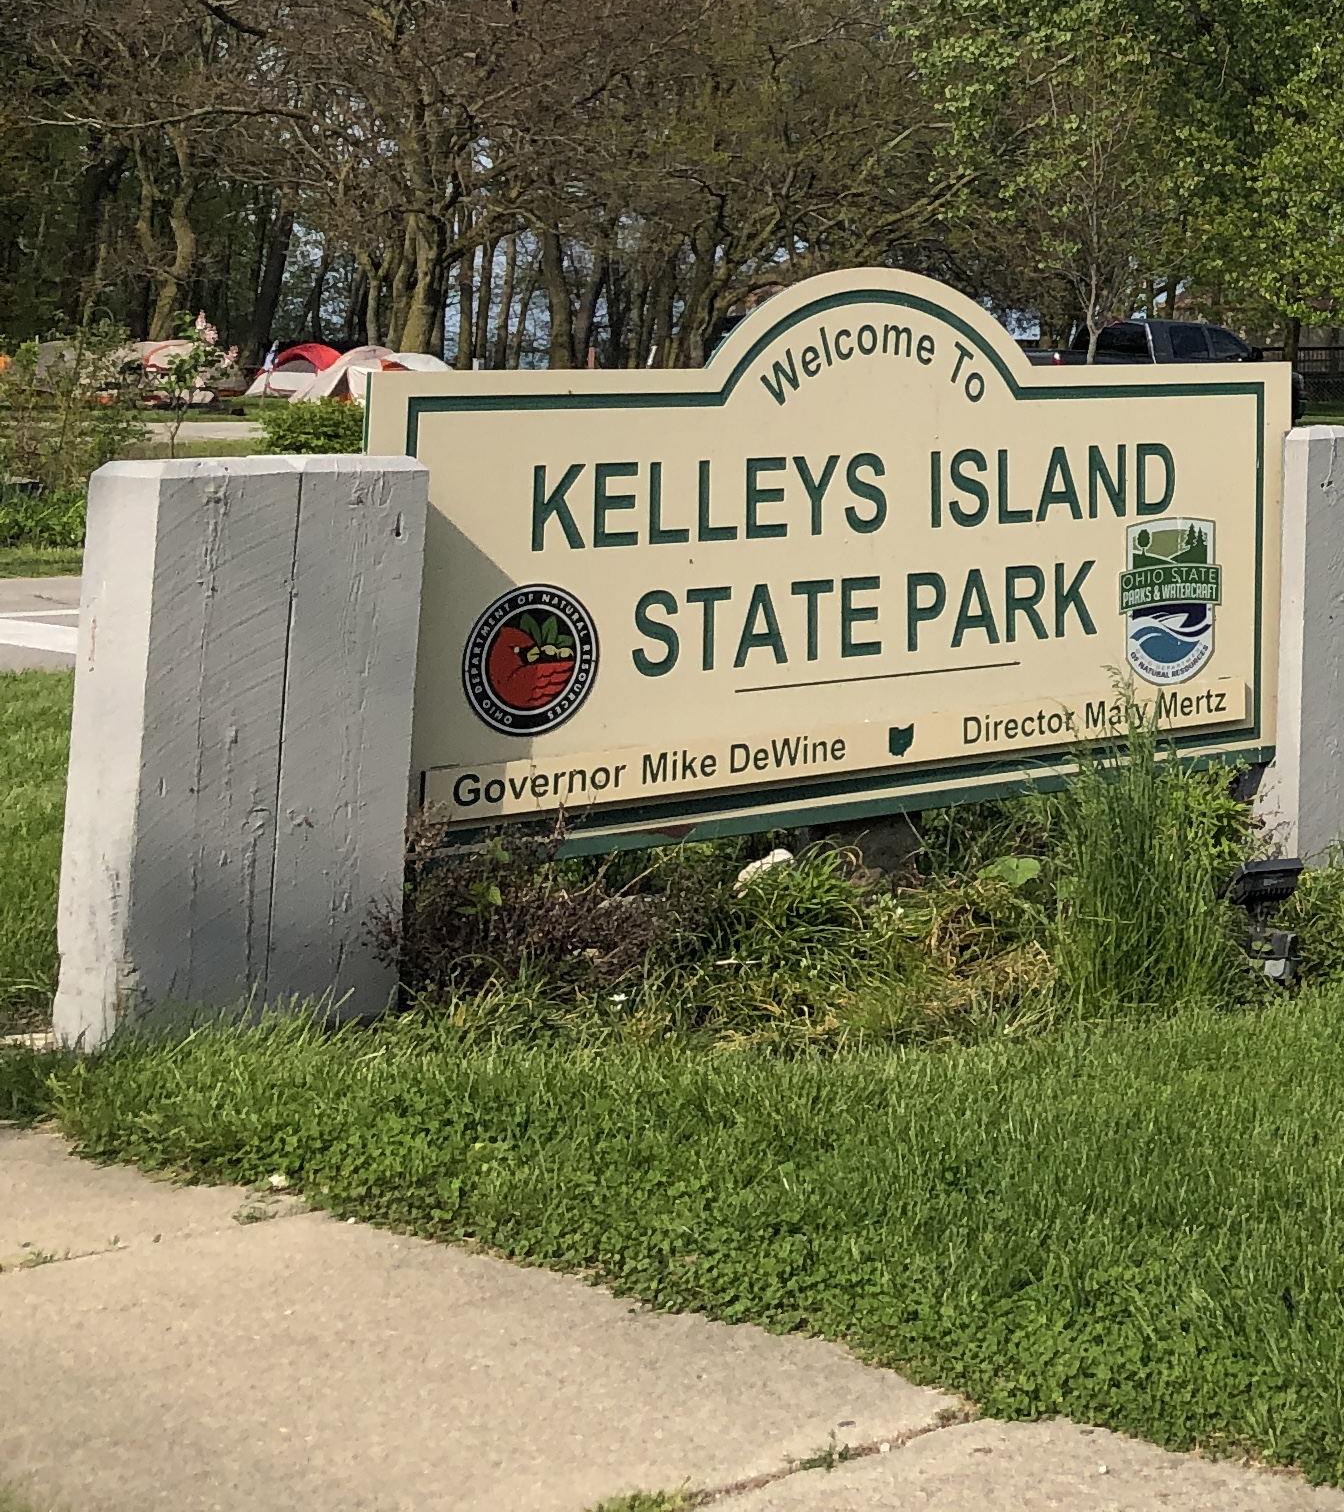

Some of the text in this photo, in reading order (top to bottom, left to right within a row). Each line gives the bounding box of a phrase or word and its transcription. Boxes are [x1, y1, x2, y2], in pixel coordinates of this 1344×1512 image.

[759, 324, 986, 407] Welcome To
[531, 443, 1176, 553] KELLEYS ISLAND
[1122, 567, 1217, 589] OHIO STATE
[1122, 583, 1217, 607] PARKS & WATERCRAFT
[631, 560, 1098, 678] STATE PARK
[470, 593, 591, 725] OHIO DEPARTMENT OF NATURAL RESOURCES
[1130, 644, 1209, 678] OF NATURAL RESOURCES
[963, 709, 1075, 745] Director
[1158, 689, 1227, 719] Mertz
[452, 735, 847, 807] Governor Mike DeWine
